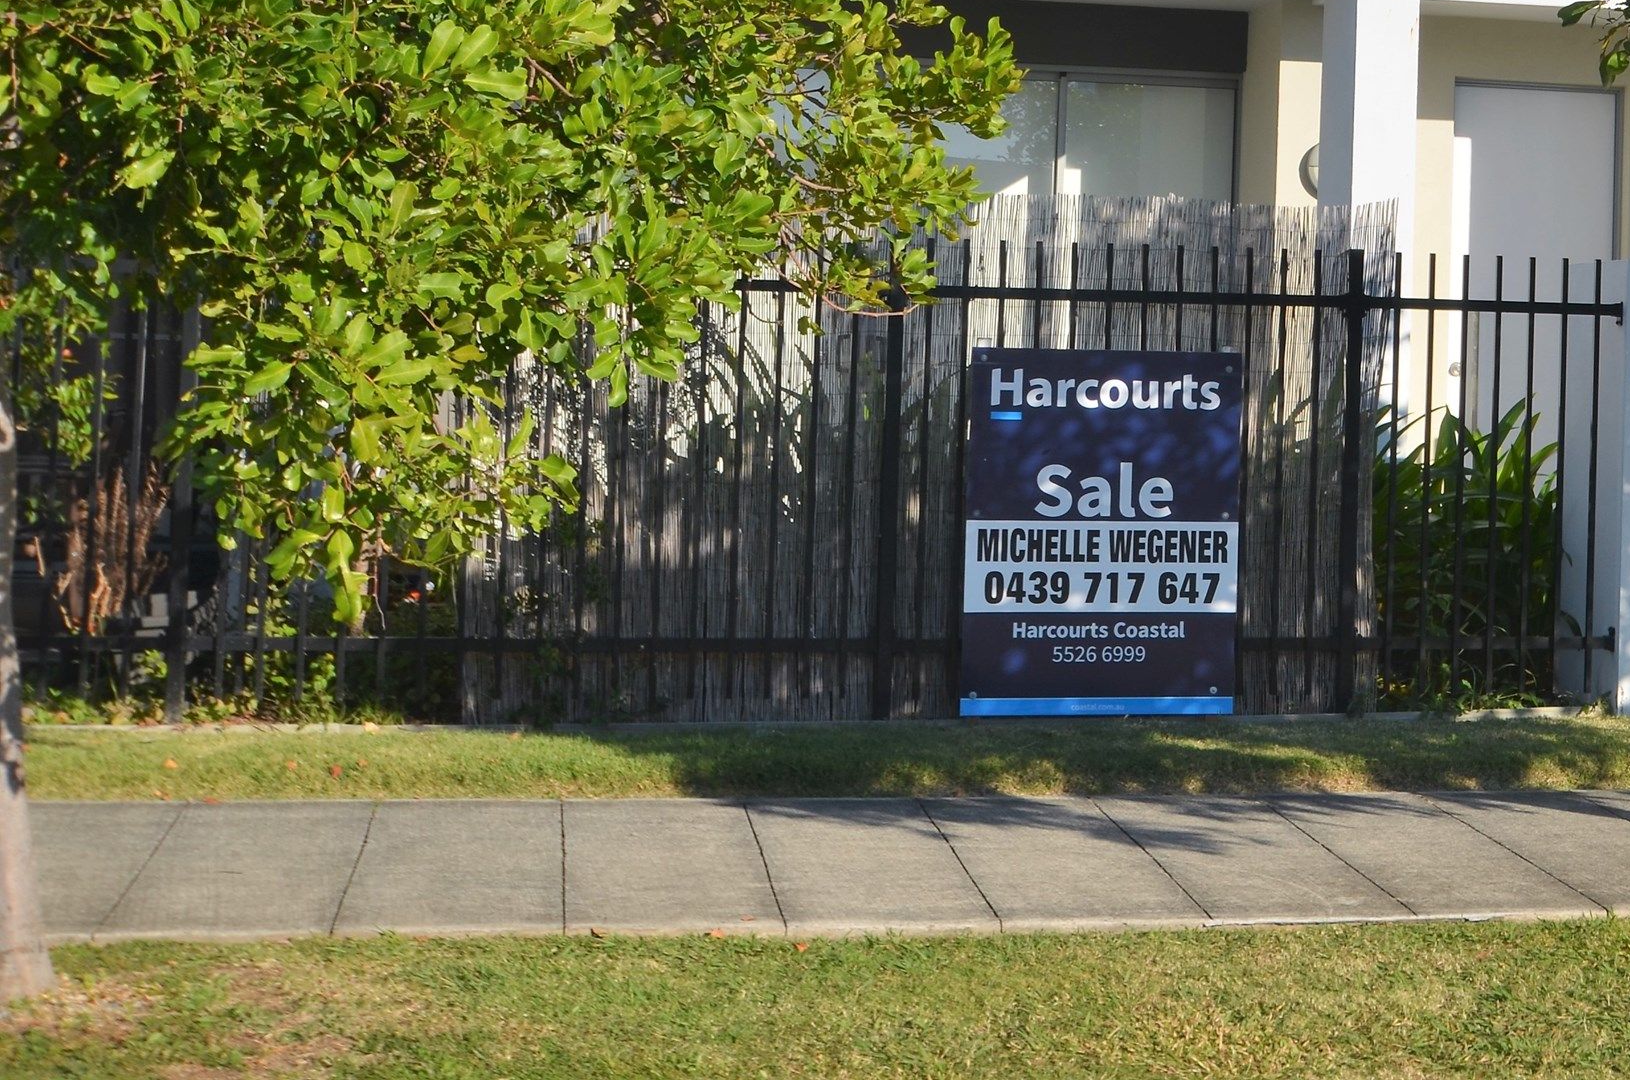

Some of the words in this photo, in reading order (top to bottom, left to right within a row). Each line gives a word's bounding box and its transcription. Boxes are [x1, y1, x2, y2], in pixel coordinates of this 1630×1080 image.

[990, 368, 1221, 411] Harcourts
[1034, 462, 1174, 518] Sale
[977, 528, 1100, 563] MICHELLE
[1109, 529, 1229, 564] WEGENER
[984, 571, 1070, 604] 0439
[1084, 571, 1145, 604] 717
[1158, 571, 1220, 604] 647
[1012, 622, 1108, 639] Harcourts
[1114, 621, 1185, 639] Coastal
[1052, 646, 1097, 663] 5526
[1102, 646, 1146, 663] 6999
